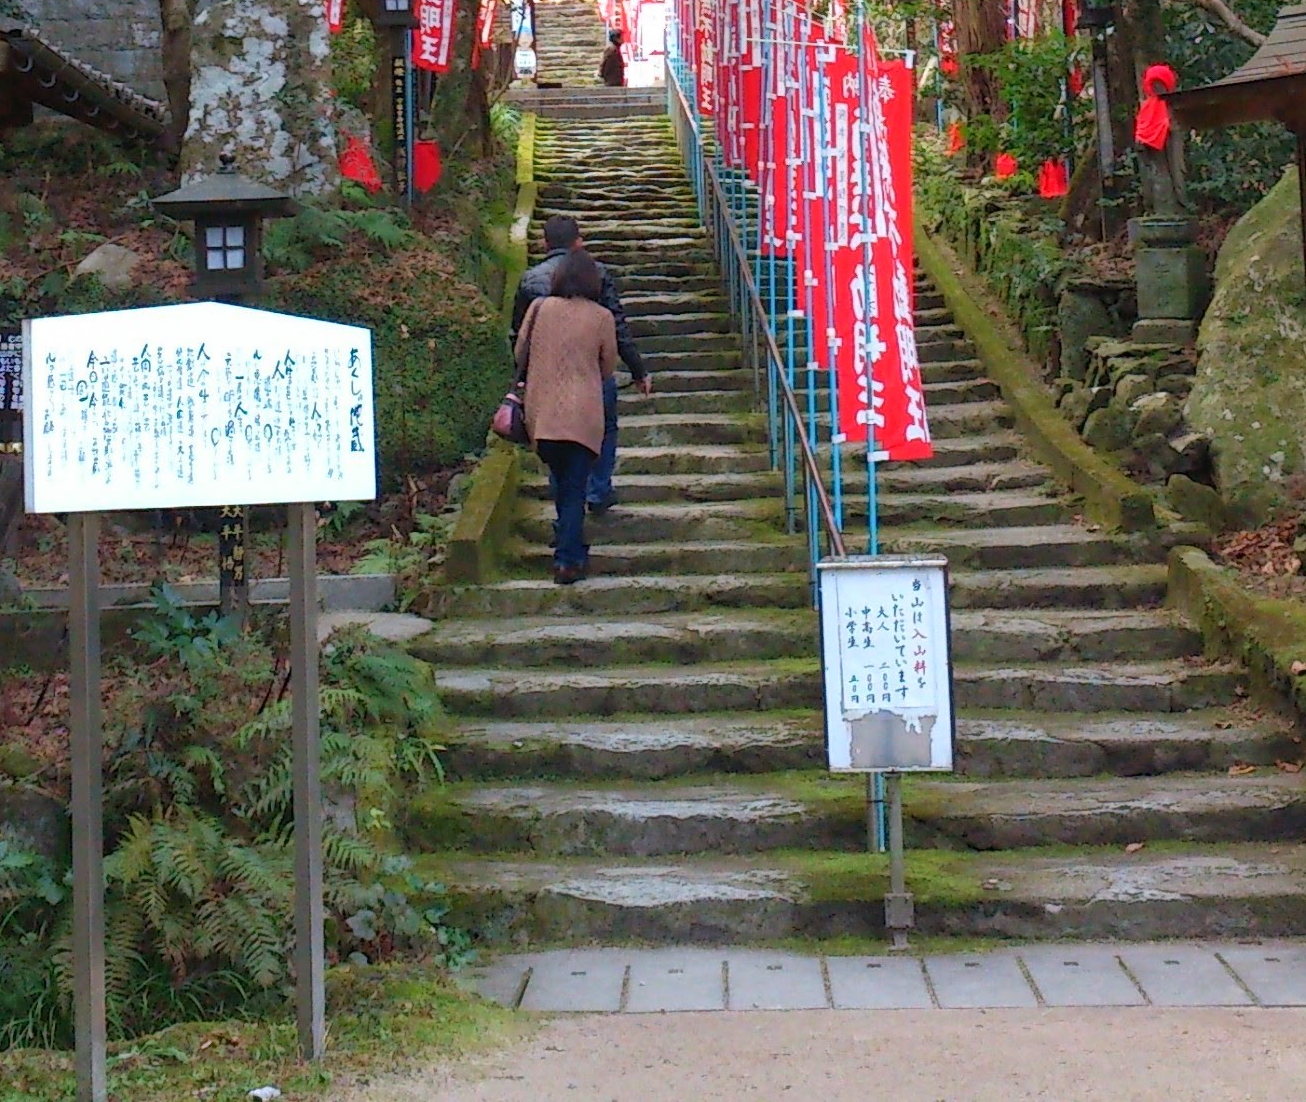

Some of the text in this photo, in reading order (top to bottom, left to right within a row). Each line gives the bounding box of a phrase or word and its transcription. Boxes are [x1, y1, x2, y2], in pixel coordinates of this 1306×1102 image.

[844, 606, 860, 649] 小学生
[861, 605, 876, 649] 中高生
[876, 606, 891, 631] 大人
[911, 578, 928, 689] 当山は入山料を
[891, 593, 910, 700] いただいています
